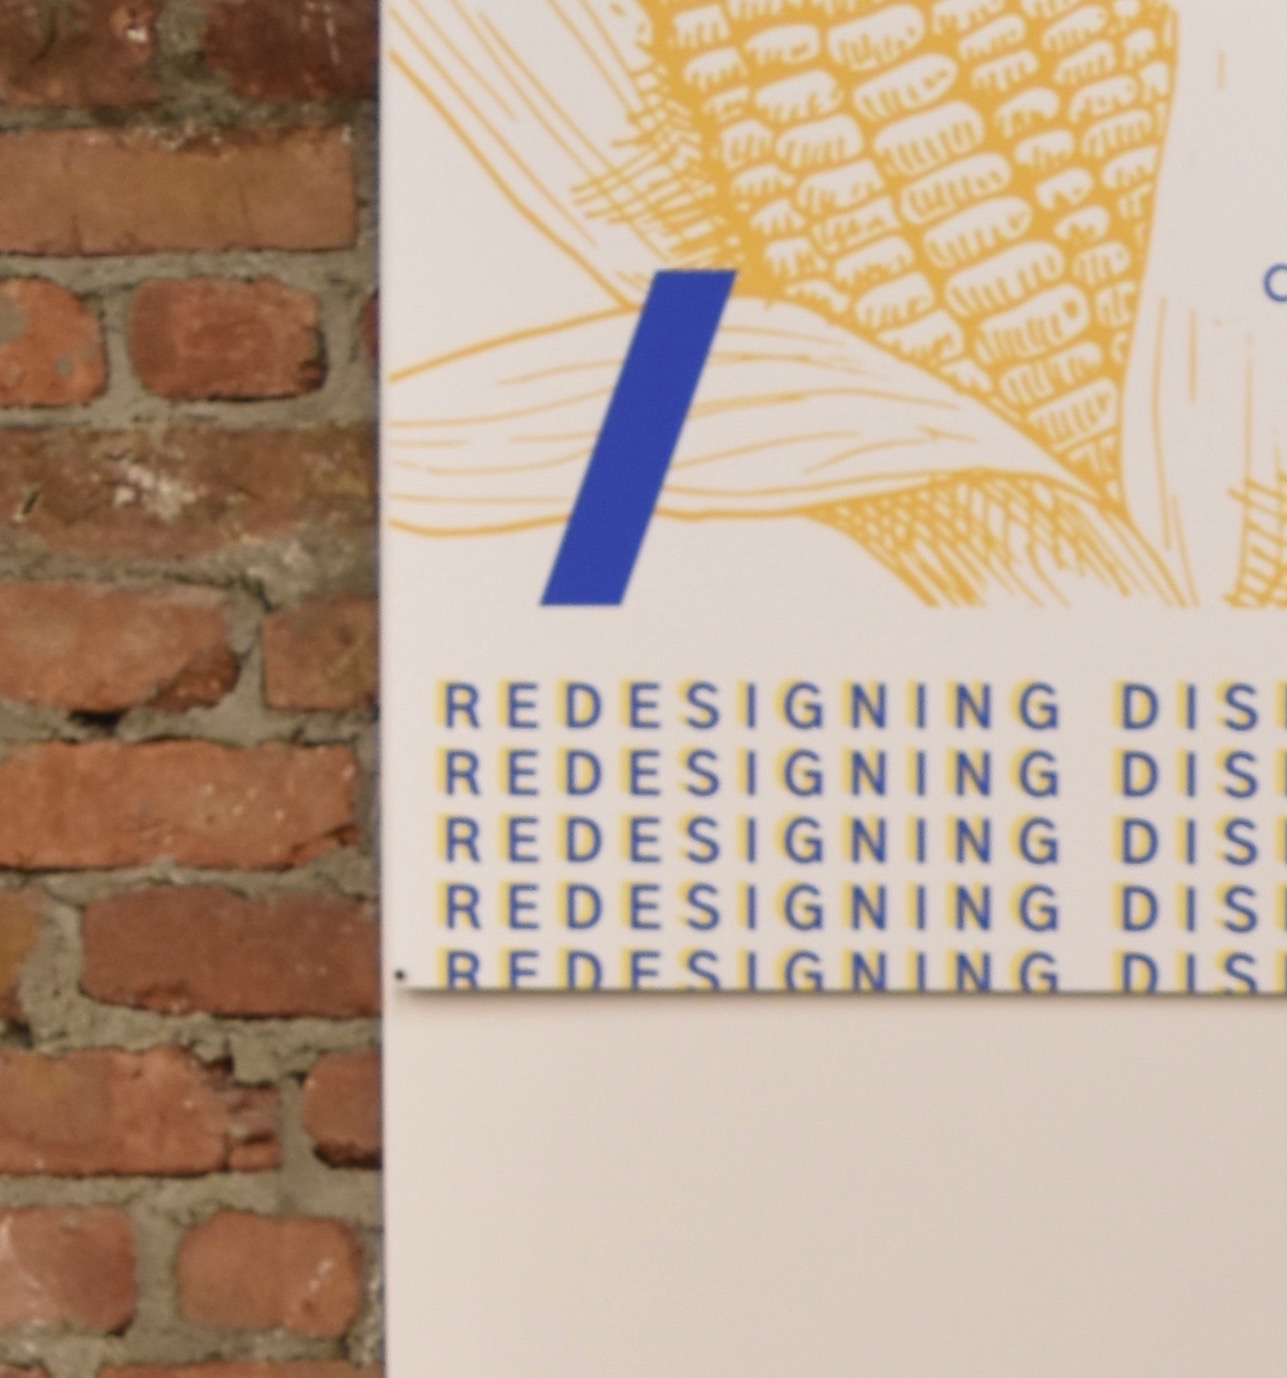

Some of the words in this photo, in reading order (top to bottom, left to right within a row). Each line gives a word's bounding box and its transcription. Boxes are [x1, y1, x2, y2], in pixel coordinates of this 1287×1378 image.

[436, 677, 1059, 729] REDESIGNING
[436, 744, 1059, 797] REDESIGNING
[436, 811, 1059, 864] REDESIGNING
[436, 878, 1059, 931] REDESIGNING
